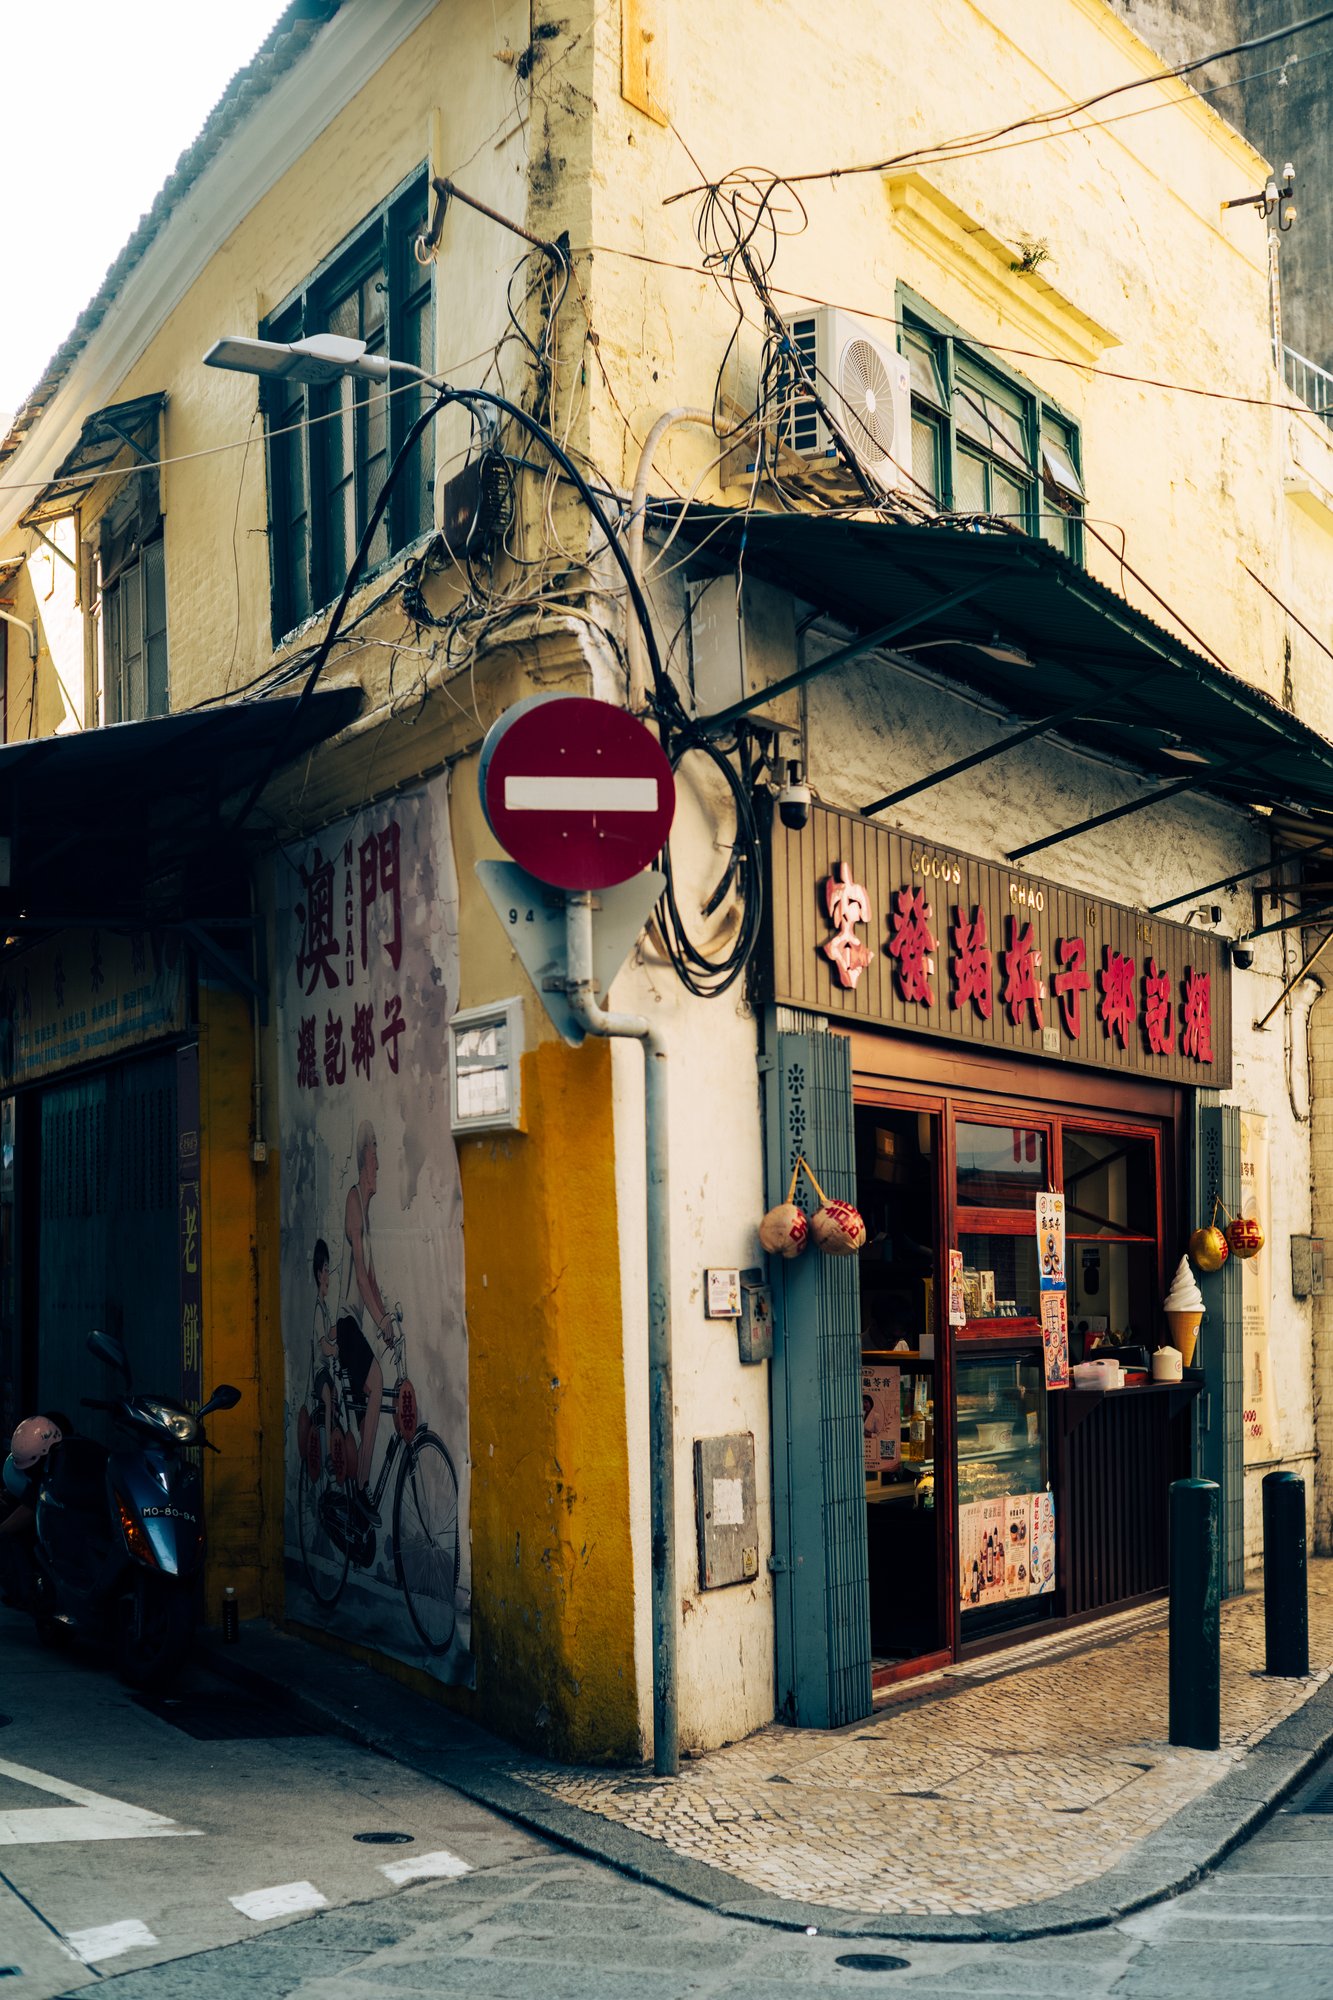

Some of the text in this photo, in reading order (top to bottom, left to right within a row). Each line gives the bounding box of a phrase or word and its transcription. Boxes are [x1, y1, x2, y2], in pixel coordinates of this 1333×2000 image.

[343, 838, 354, 988] MACAU
[910, 849, 962, 886] COCOS
[1009, 883, 1045, 912] CHAO
